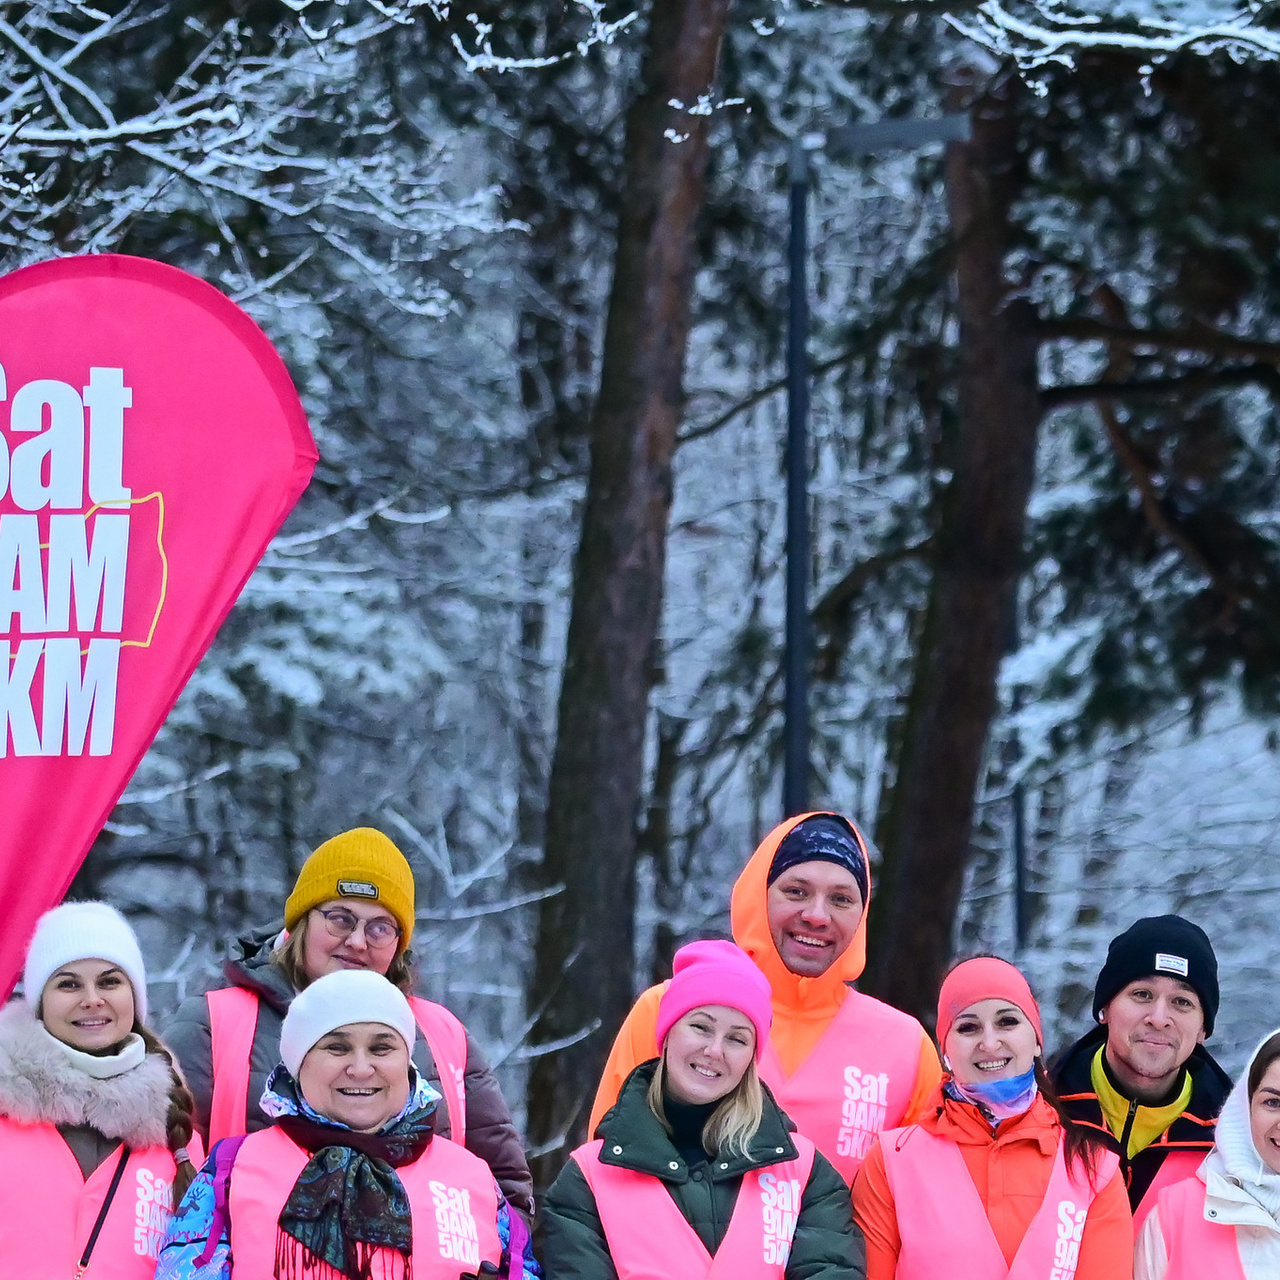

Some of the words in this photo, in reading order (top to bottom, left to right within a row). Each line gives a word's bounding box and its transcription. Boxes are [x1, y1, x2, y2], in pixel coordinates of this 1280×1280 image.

[843, 1065, 889, 1107] Sat
[841, 1100, 887, 1133] 9AM
[428, 1180, 470, 1217] Sat
[758, 1172, 801, 1215] Sat
[435, 1207, 480, 1243] 9AM
[438, 1231, 481, 1268] 5KM
